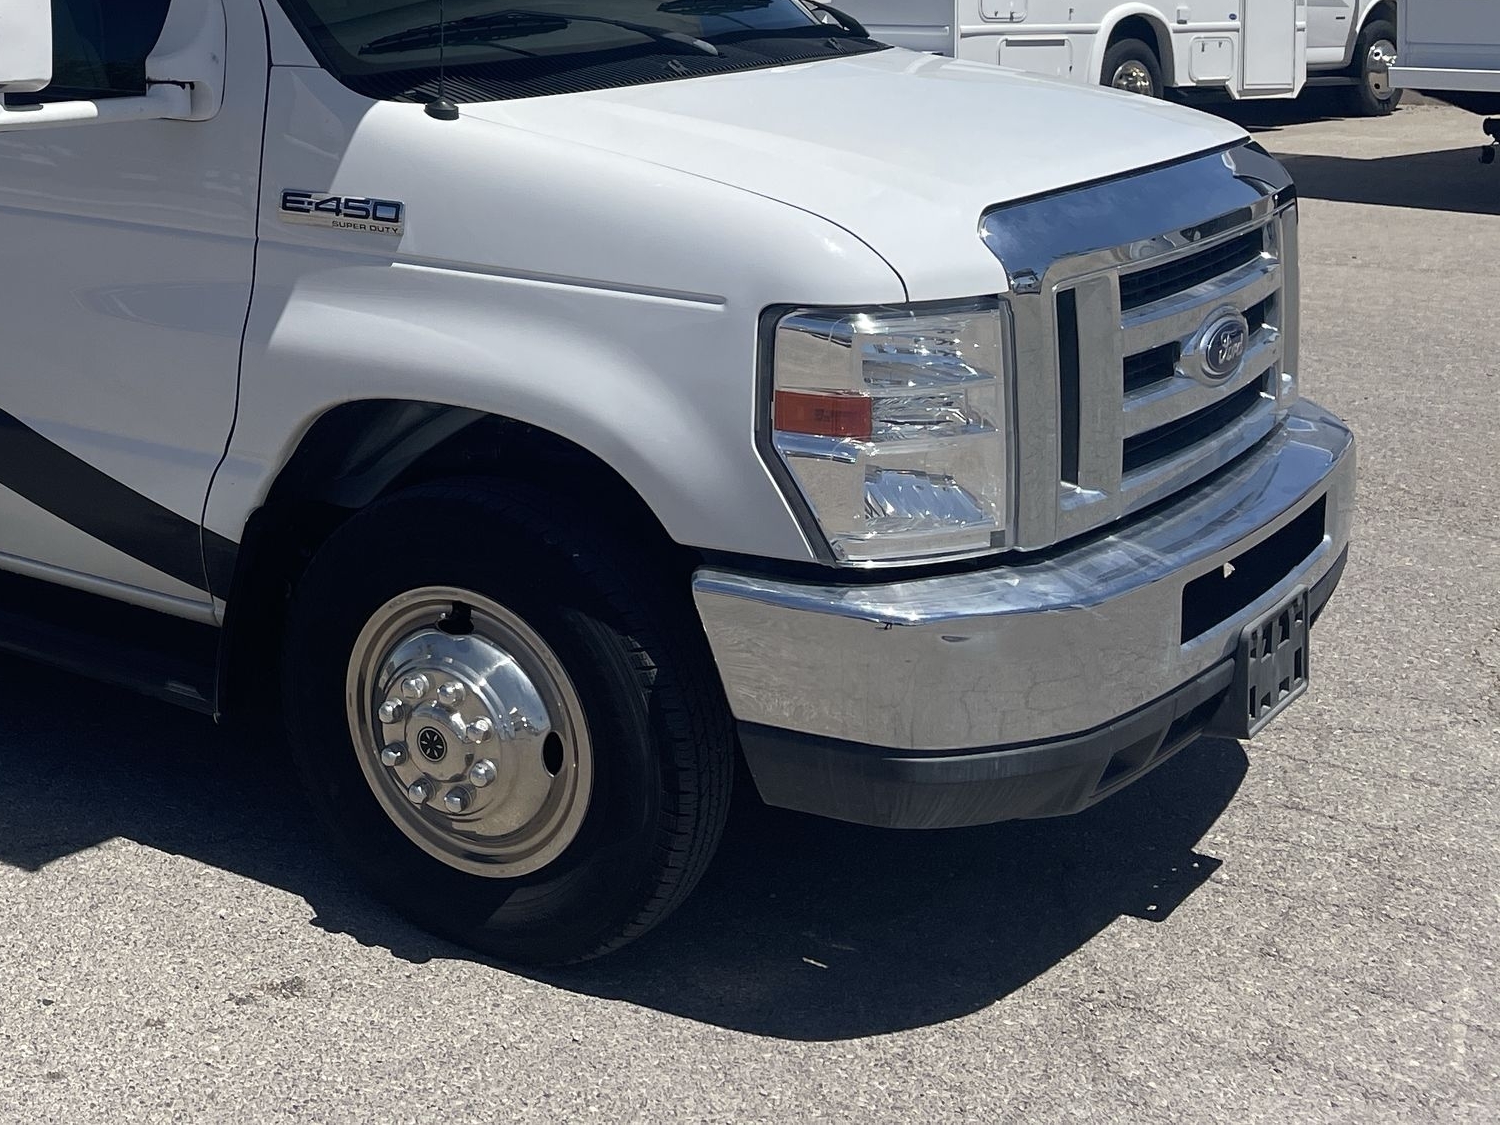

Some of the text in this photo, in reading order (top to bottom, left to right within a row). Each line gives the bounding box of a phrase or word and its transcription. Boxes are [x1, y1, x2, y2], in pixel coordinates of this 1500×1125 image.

[332, 220, 399, 234] SUPER DUTY
[1218, 331, 1244, 365] Ford
